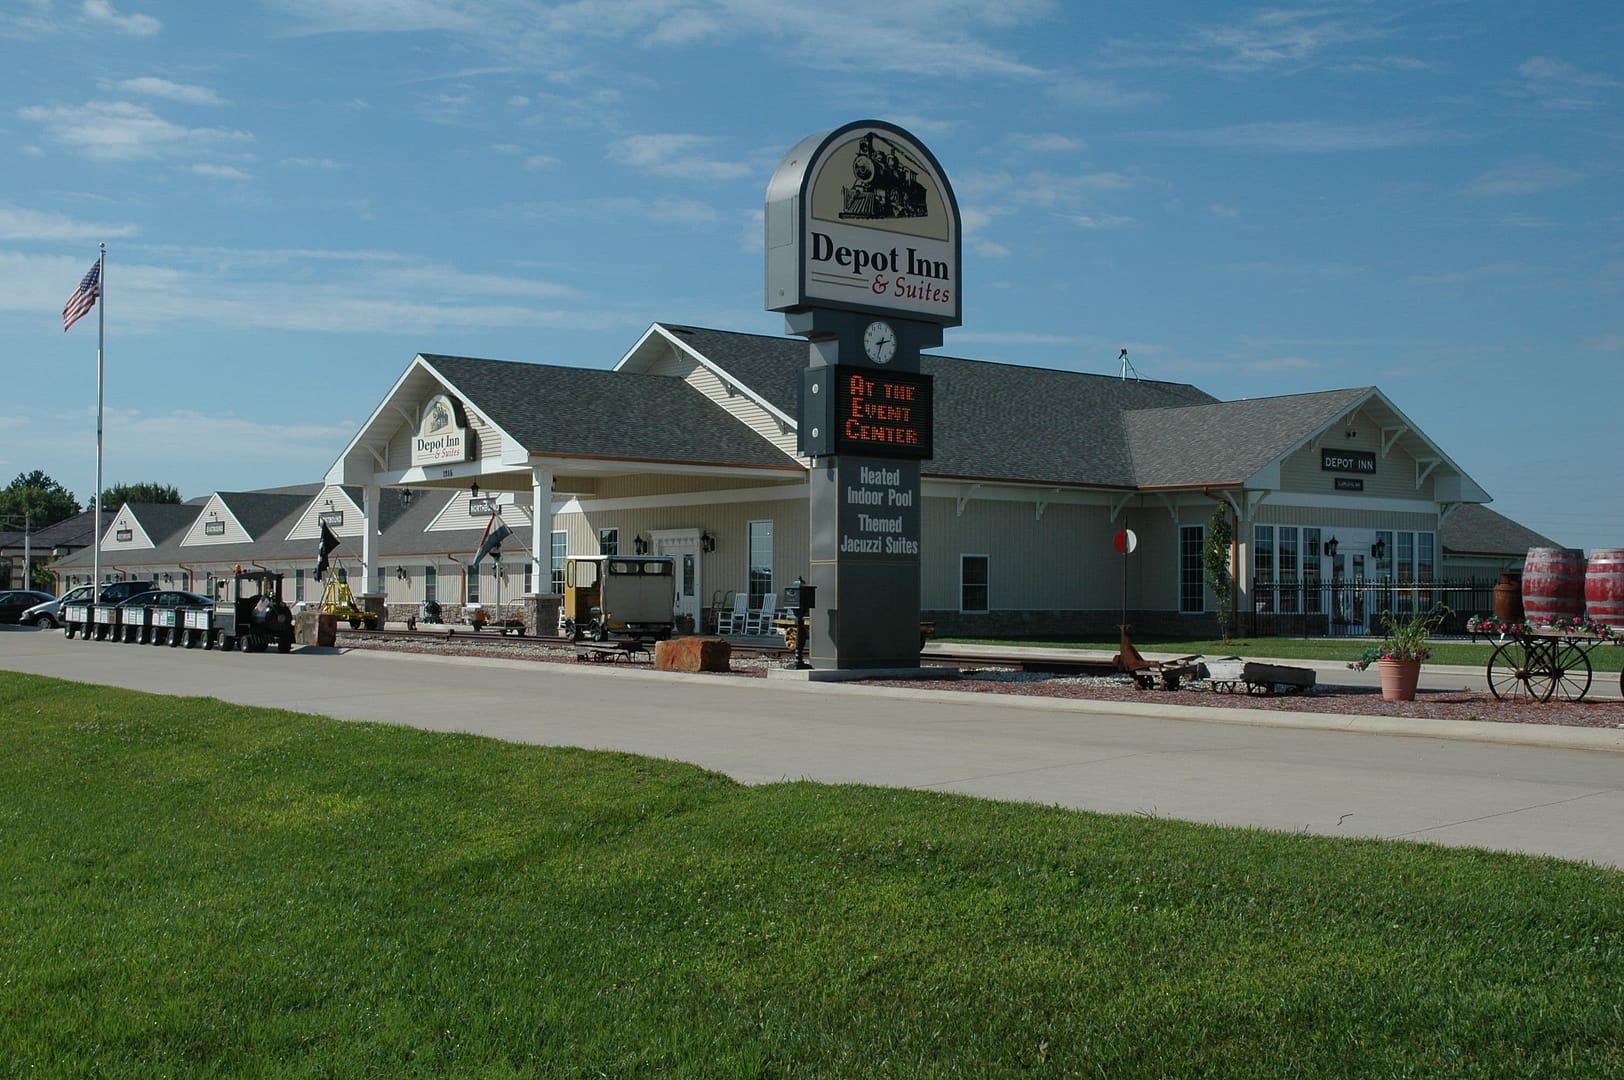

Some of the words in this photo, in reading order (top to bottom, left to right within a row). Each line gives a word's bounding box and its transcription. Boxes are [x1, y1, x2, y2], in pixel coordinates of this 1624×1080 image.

[811, 232, 899, 275] Depot
[906, 247, 949, 280] Inn
[872, 274, 889, 294] &
[894, 276, 950, 303] Suites
[417, 437, 444, 452] Depot
[446, 435, 460, 447] Inn
[434, 449, 440, 459] &
[441, 447, 460, 458] Suites
[1325, 457, 1354, 468] DEPOT
[1358, 459, 1374, 470] INN
[860, 466, 900, 486] Heated
[847, 486, 884, 505] Indoor
[888, 488, 912, 507] Pool
[858, 513, 902, 533] Themed
[840, 535, 882, 553] Jacuzzi
[885, 536, 918, 554] Suites
